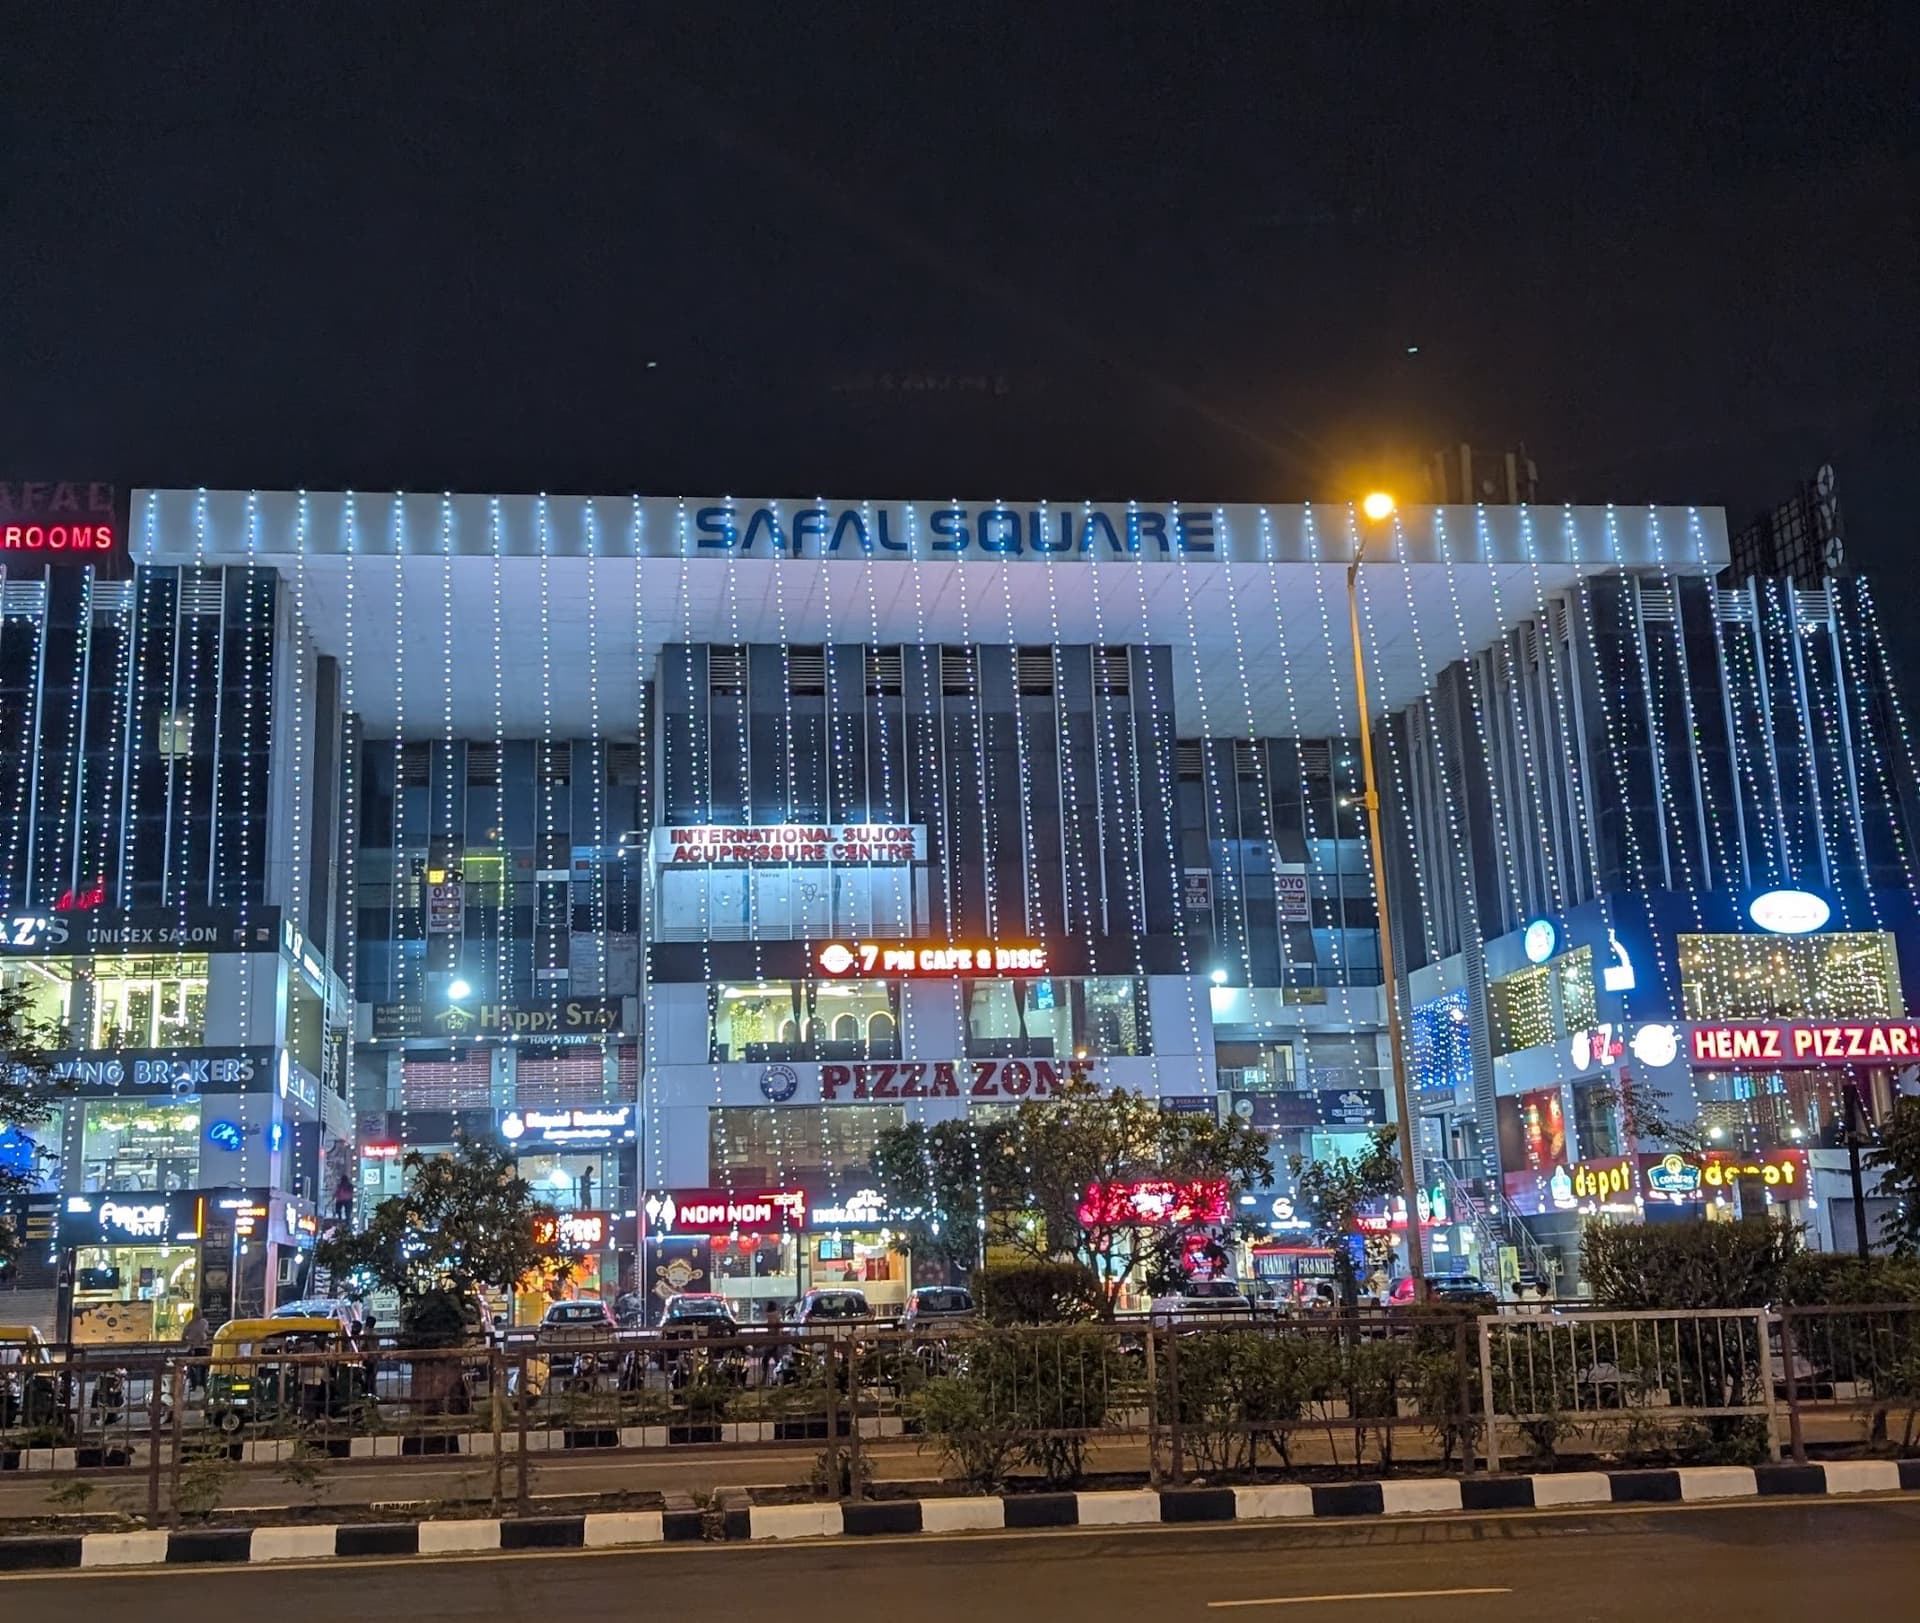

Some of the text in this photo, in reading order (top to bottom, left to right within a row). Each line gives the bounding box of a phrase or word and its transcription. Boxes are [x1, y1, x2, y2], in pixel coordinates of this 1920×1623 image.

[5, 526, 112, 548] ROOMS
[696, 507, 1216, 555] SAFAL SQUARE
[670, 826, 916, 844] INTERNATIONAL SUJOK
[672, 843, 916, 863] ACUPRESSURE CENTRE
[1280, 878, 1304, 889] OYO
[87, 926, 218, 944] UNISEX SALON
[860, 945, 879, 971] 7
[883, 950, 916, 970] PM
[919, 949, 973, 970] CAFE
[530, 1035, 561, 1044] HAPPY
[564, 1035, 587, 1044] STAY
[1695, 1030, 1782, 1058] HEMZ
[820, 1061, 960, 1100] PIZZA
[1575, 1160, 1631, 1202] depot
[680, 1203, 771, 1224] NOM NOM
[1298, 1257, 1335, 1275] FRANKIE
